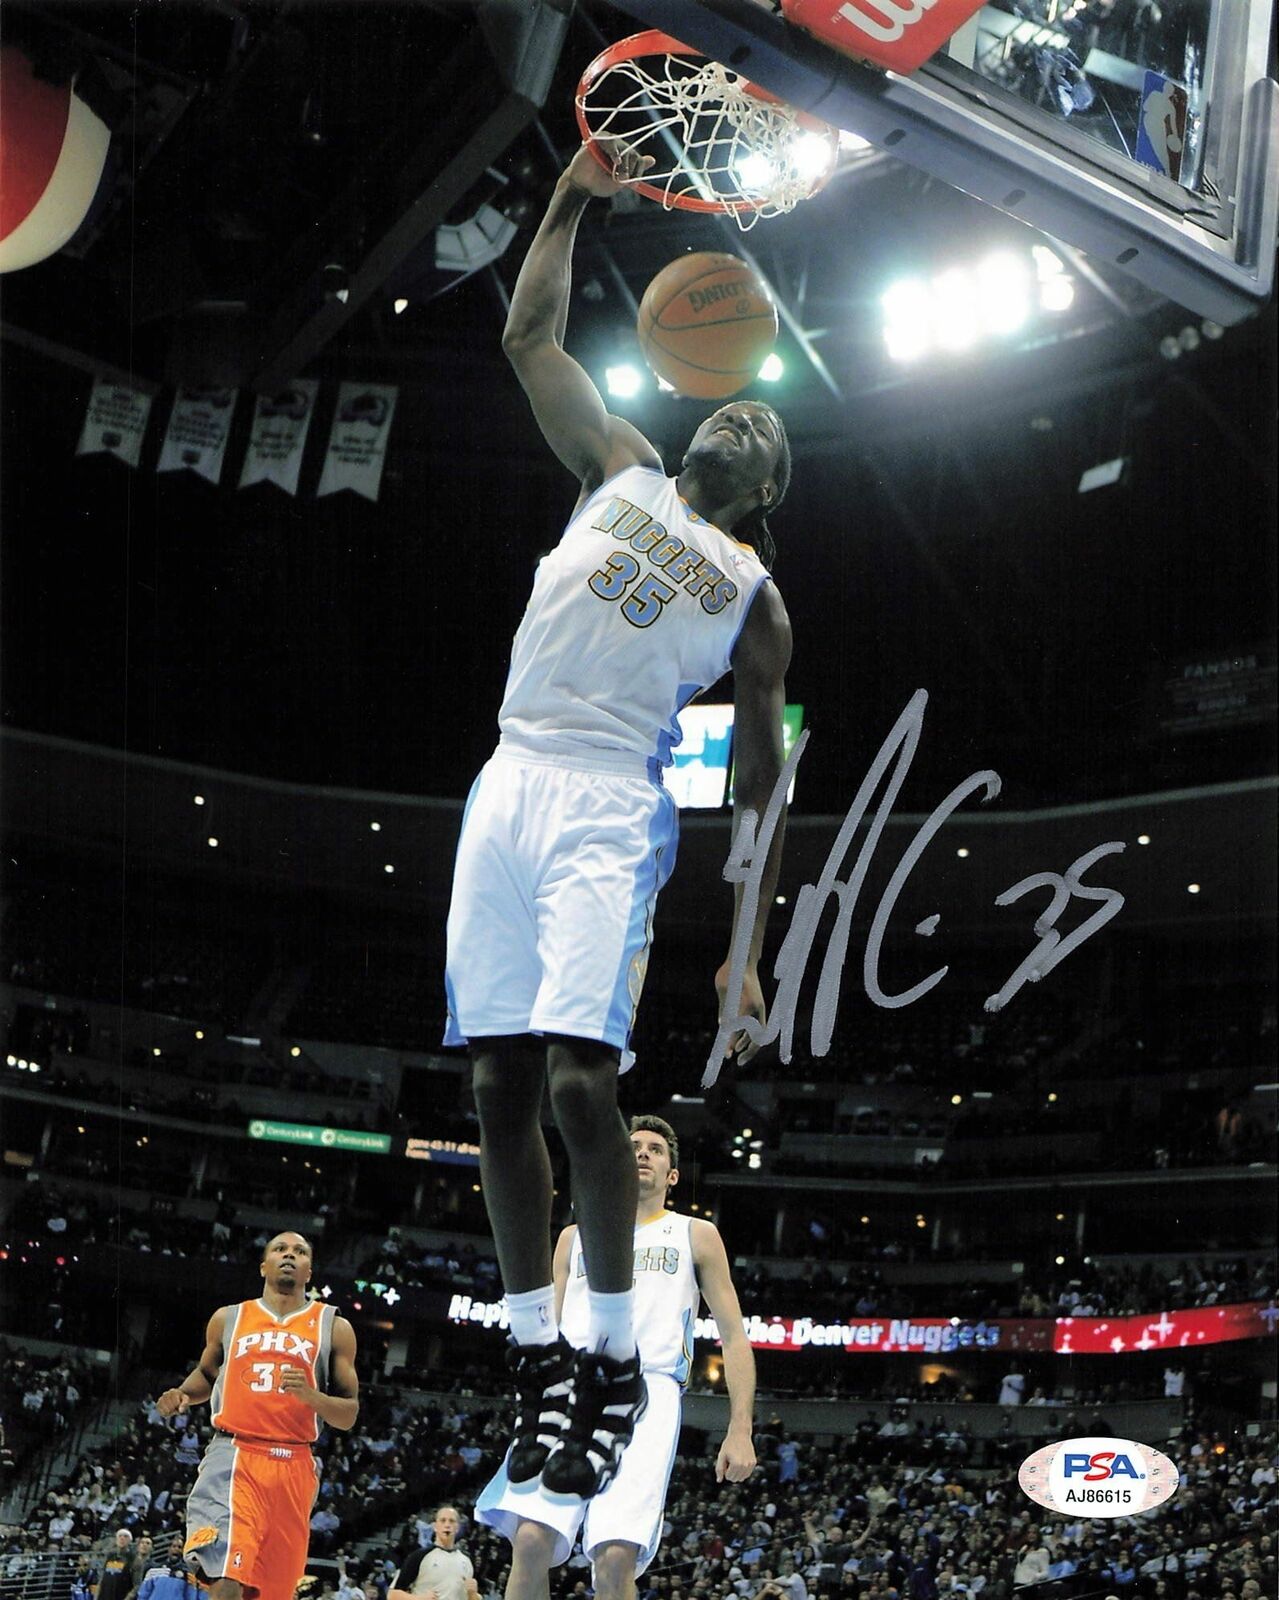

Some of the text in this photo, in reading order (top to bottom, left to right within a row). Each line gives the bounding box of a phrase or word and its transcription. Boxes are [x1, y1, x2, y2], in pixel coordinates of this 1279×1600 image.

[588, 551, 678, 628] 35
[590, 496, 738, 615] NUGGETS
[235, 1330, 314, 1365] PHX
[448, 1294, 512, 1329] Happ
[742, 1315, 787, 1344] the
[791, 1319, 883, 1346] Denver
[889, 1319, 1000, 1353] Nuggets
